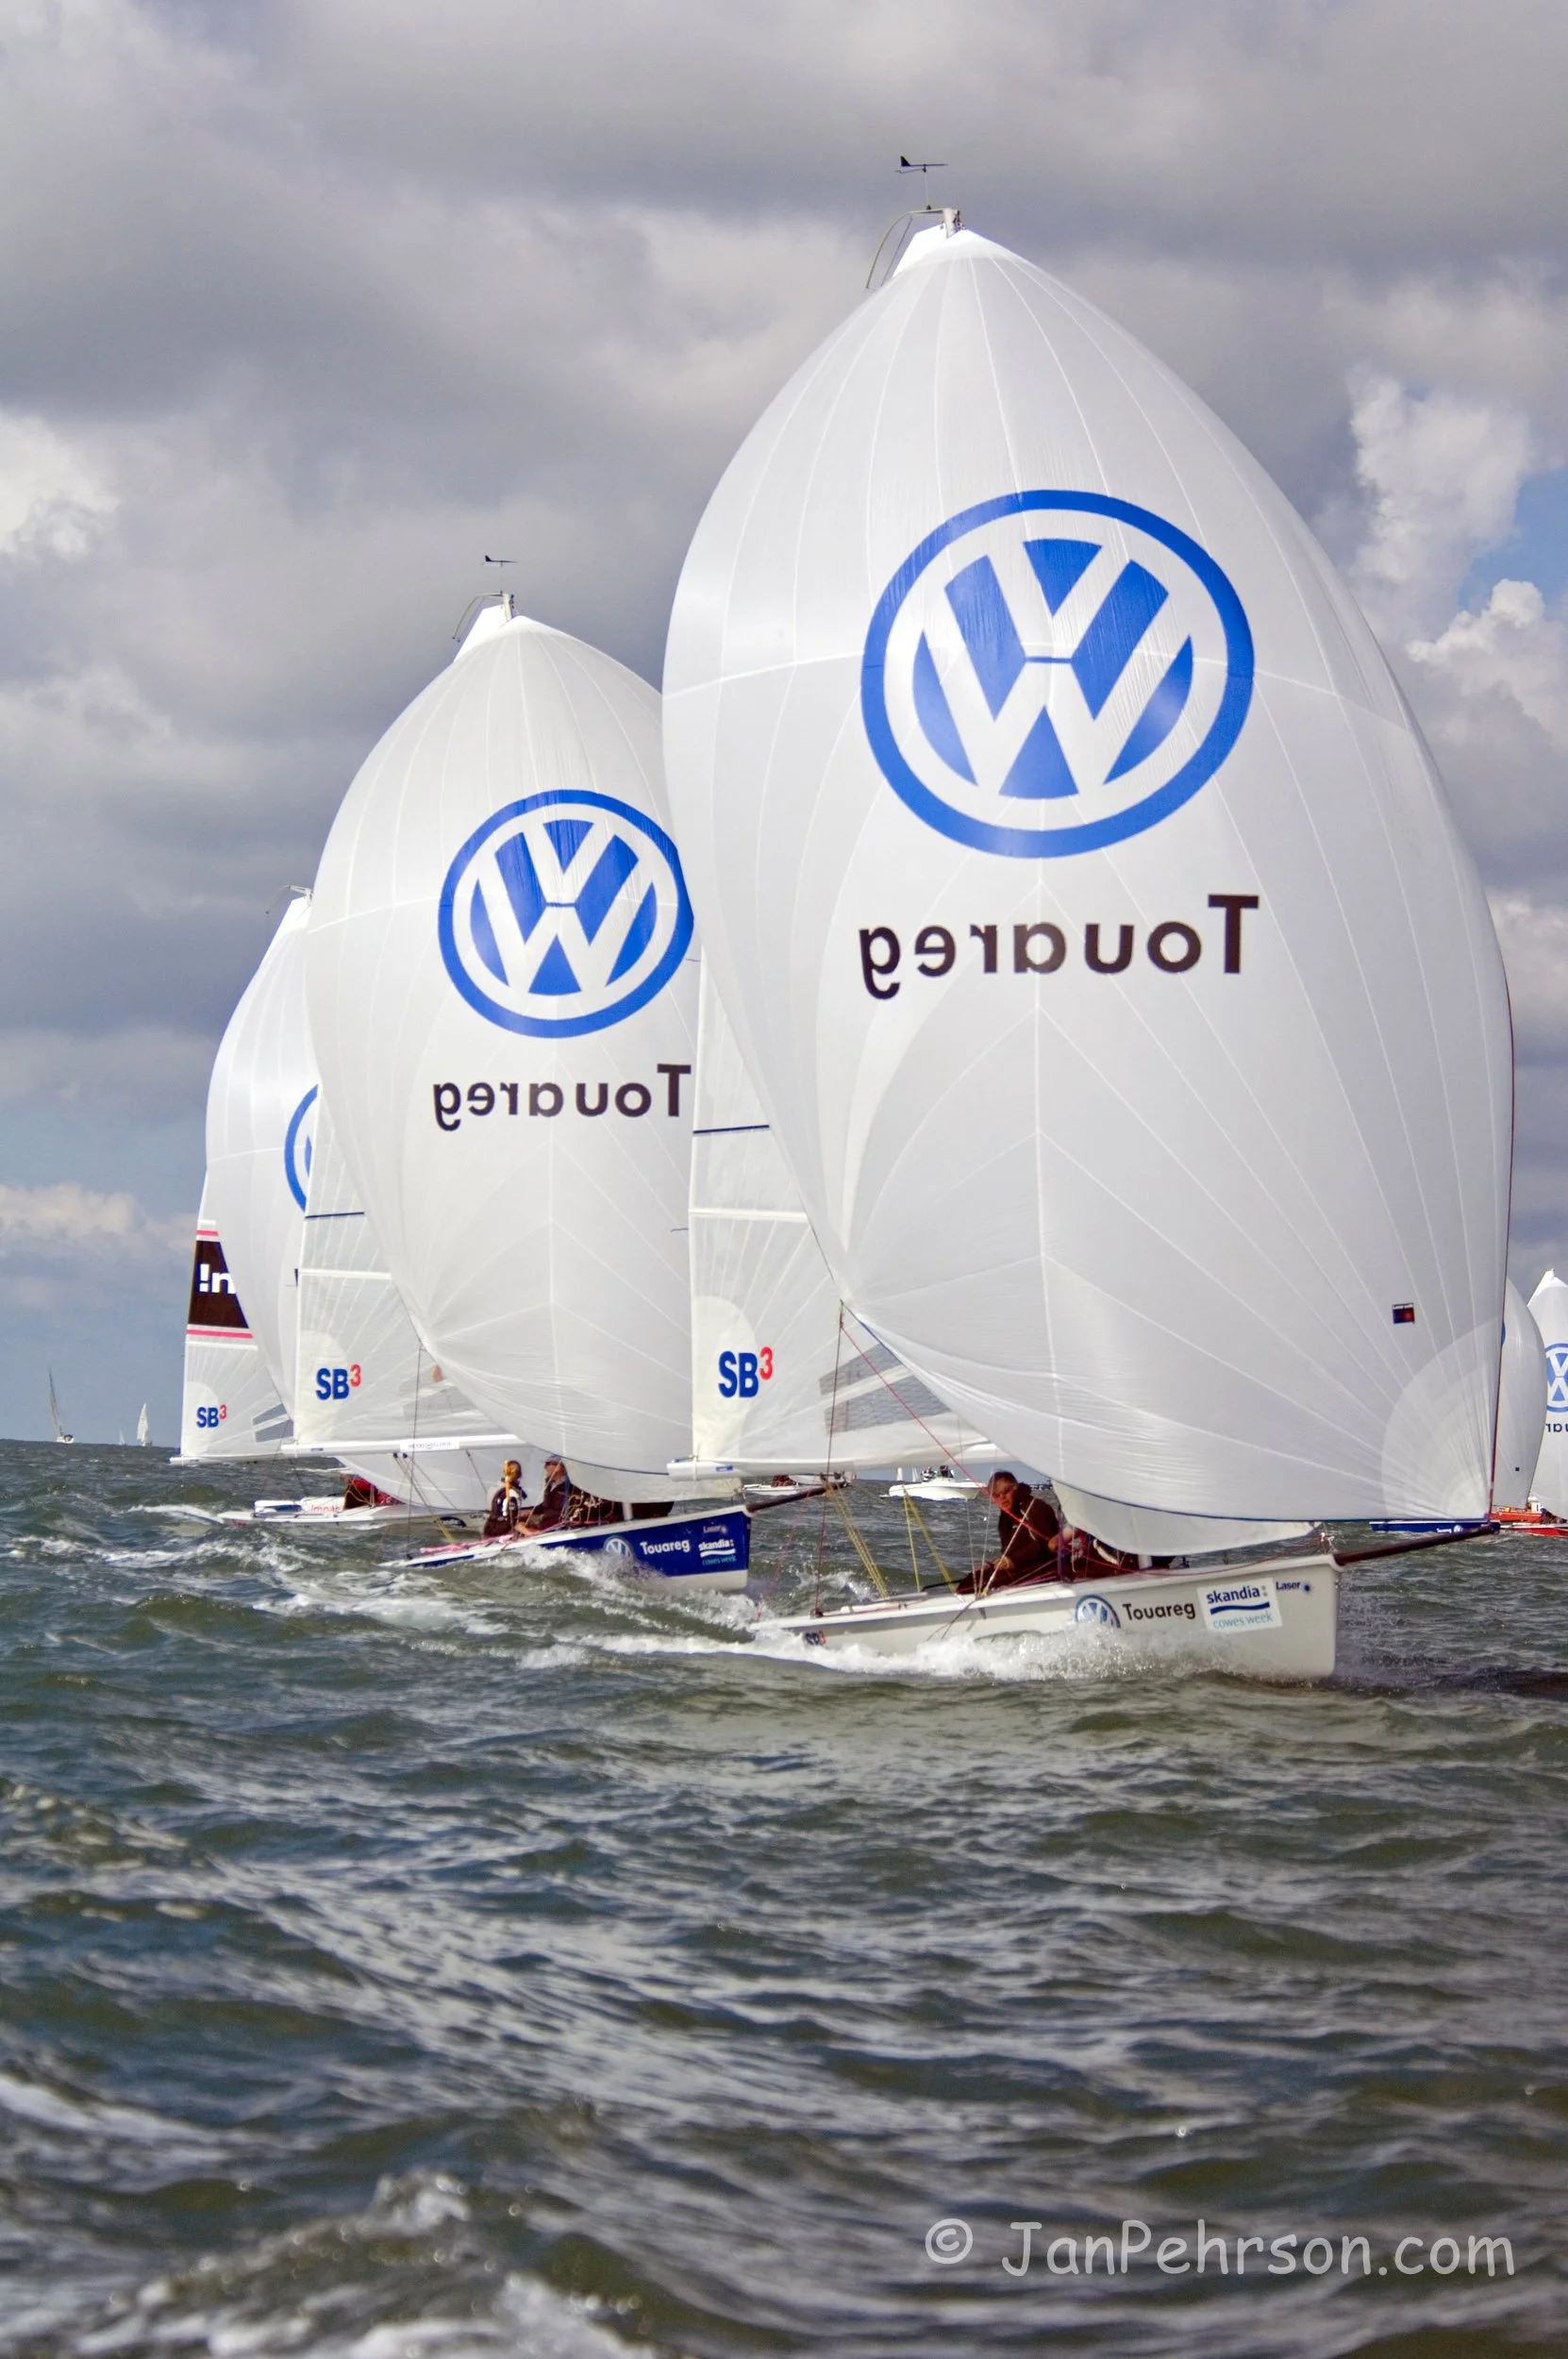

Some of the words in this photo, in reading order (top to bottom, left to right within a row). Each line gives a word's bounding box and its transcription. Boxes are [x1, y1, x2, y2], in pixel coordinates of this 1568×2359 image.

[316, 1364, 361, 1400] SB3
[718, 1347, 774, 1397] SB3
[196, 1404, 227, 1428] SB3
[640, 1539, 691, 1555] Touareg
[1276, 1581, 1301, 1590] Laser
[1122, 1601, 1195, 1621] Touareg
[1213, 1615, 1245, 1630] cowes
[1246, 1610, 1273, 1625] week
